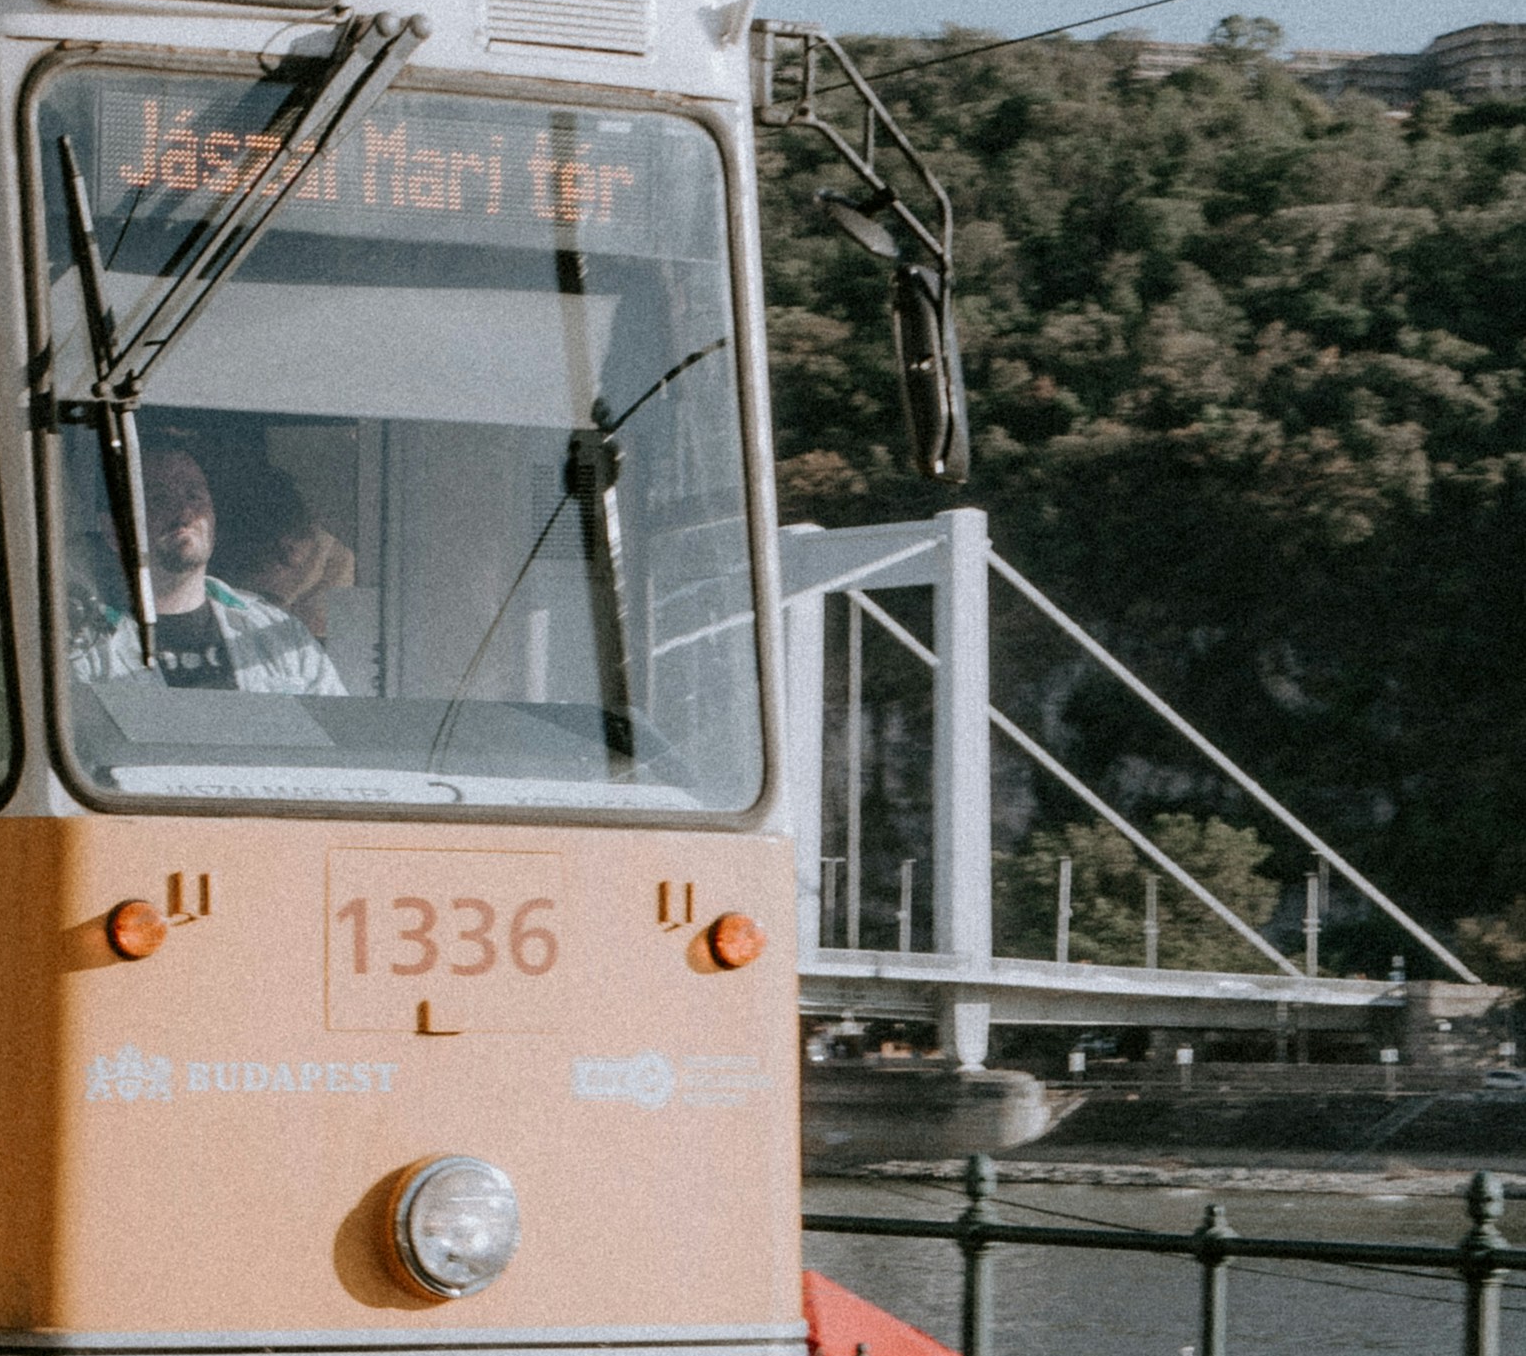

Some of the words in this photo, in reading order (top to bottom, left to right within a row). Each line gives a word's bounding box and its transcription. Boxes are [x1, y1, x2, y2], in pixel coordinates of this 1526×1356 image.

[362, 118, 504, 215] Mari
[526, 130, 635, 223] tér
[333, 895, 560, 978] 1336
[186, 1061, 400, 1093] BUDAPEST
